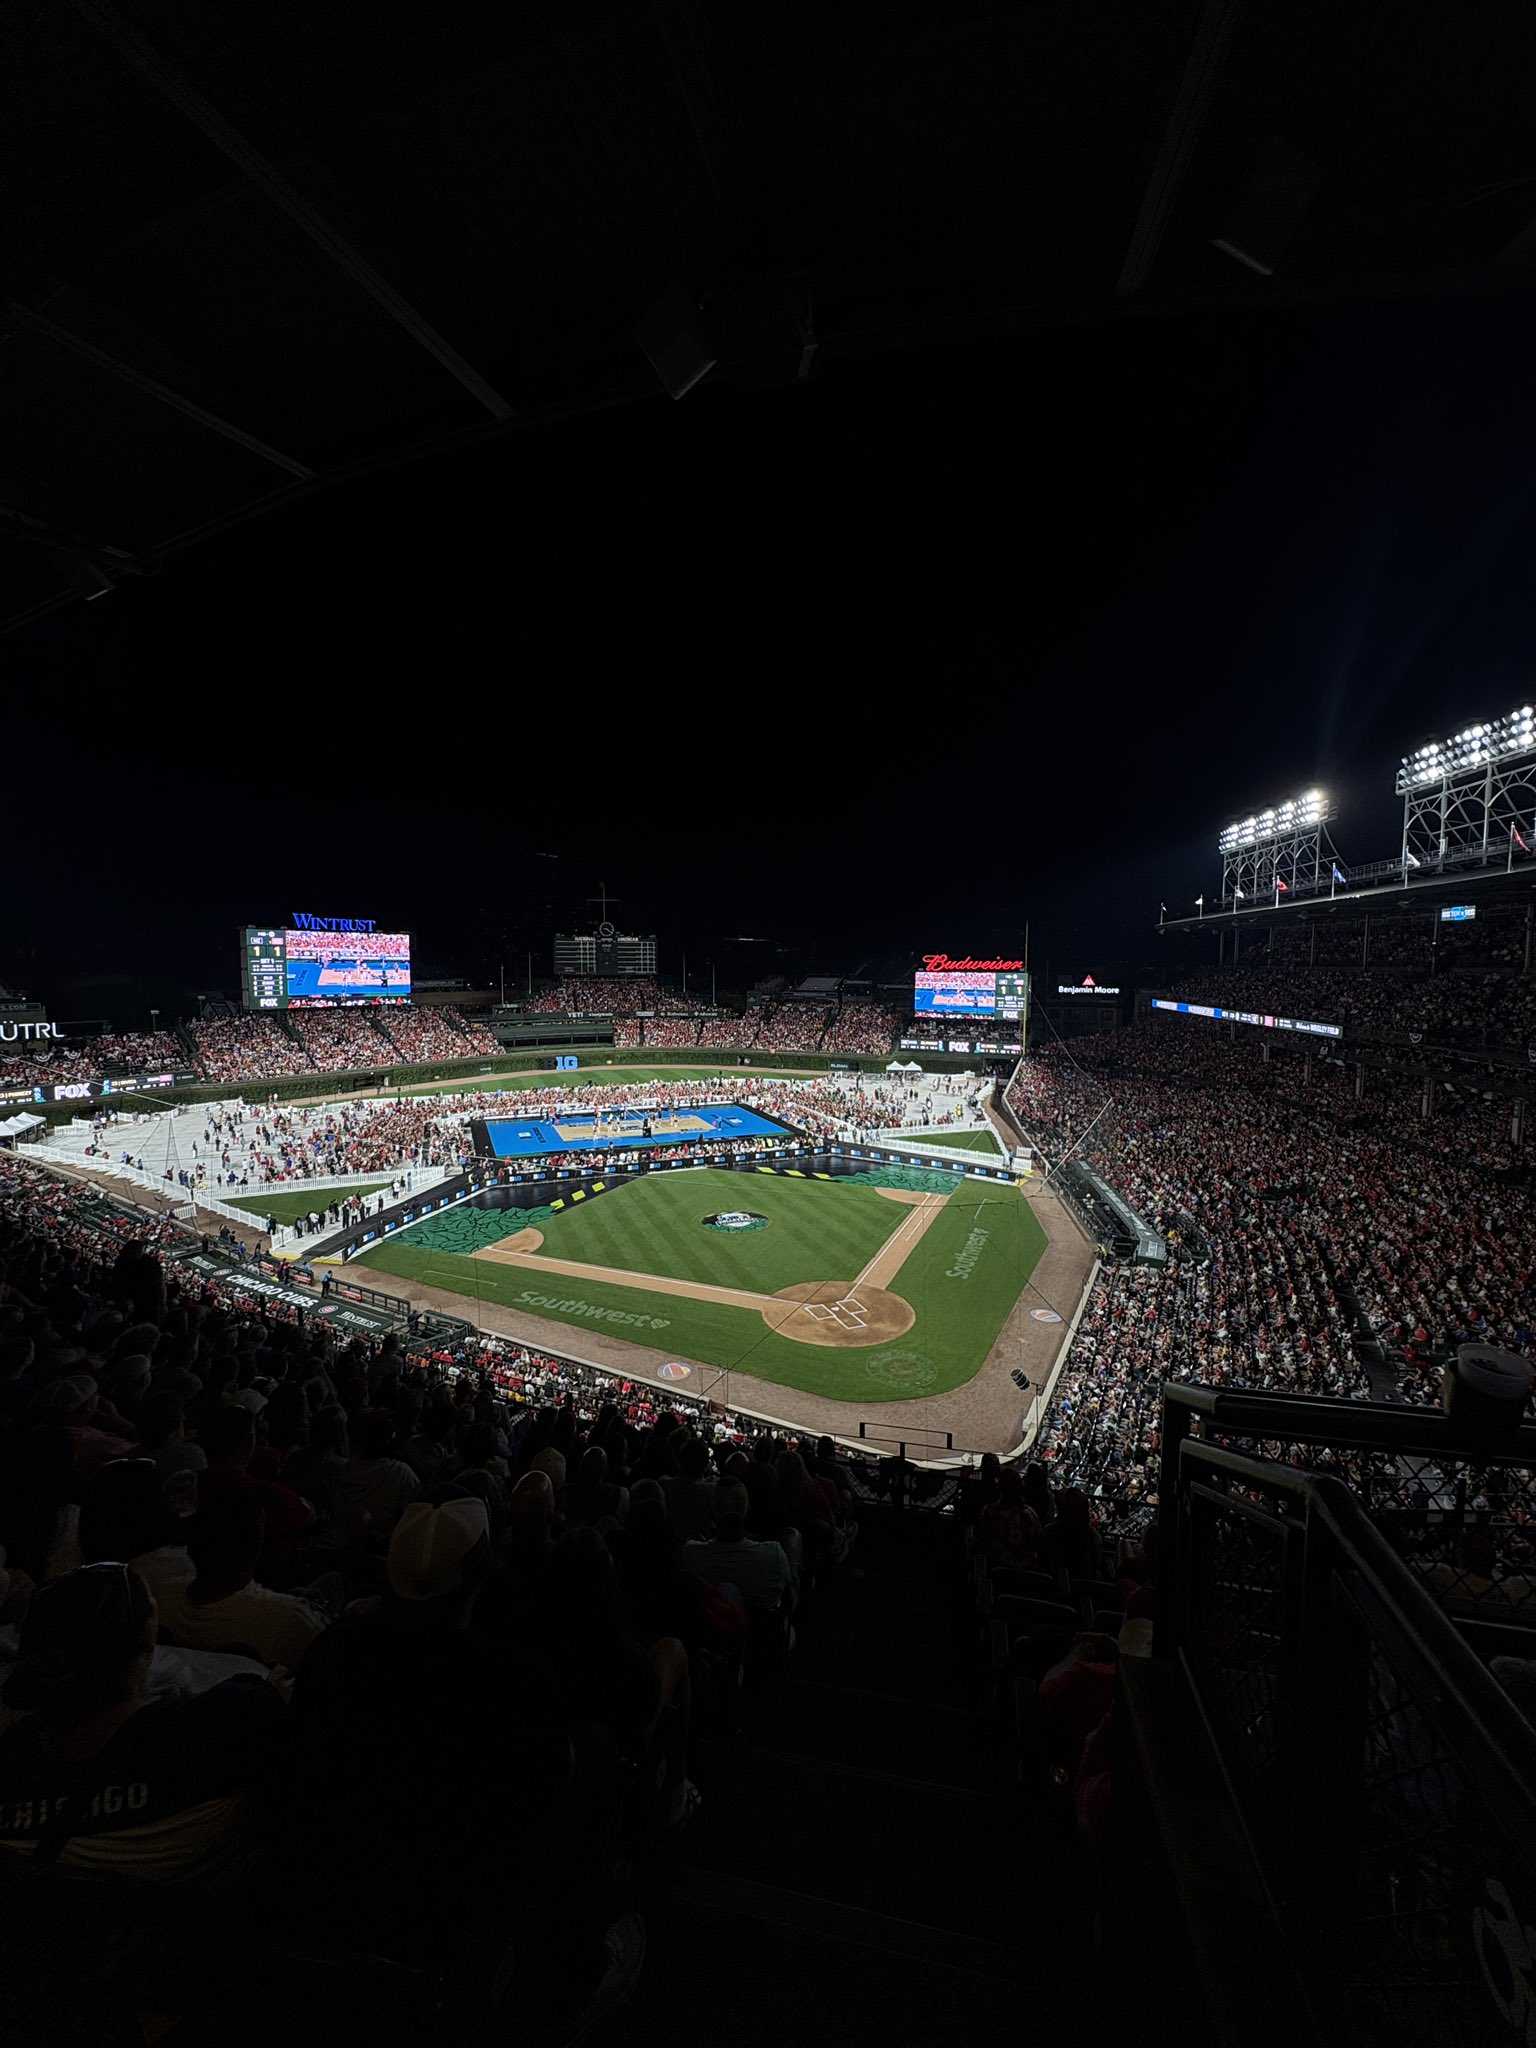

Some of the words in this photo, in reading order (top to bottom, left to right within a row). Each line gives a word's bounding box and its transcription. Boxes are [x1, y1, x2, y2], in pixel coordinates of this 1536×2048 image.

[292, 912, 376, 932] WINTRUST
[253, 945, 260, 957] 1
[273, 945, 281, 957] 1
[922, 954, 1024, 972] Budweiser
[1058, 985, 1093, 995] Benjamin
[1094, 986, 1120, 994] Moore
[260, 998, 278, 1008] FOX
[1002, 1010, 1018, 1020] FOX
[948, 1041, 970, 1053] FOX
[54, 1082, 91, 1101] FOX
[226, 1274, 283, 1297] CHICAGO
[280, 1291, 319, 1308] CUBS
[512, 1291, 650, 1329] Southwest
[0, 1782, 151, 1834] CHIGO
